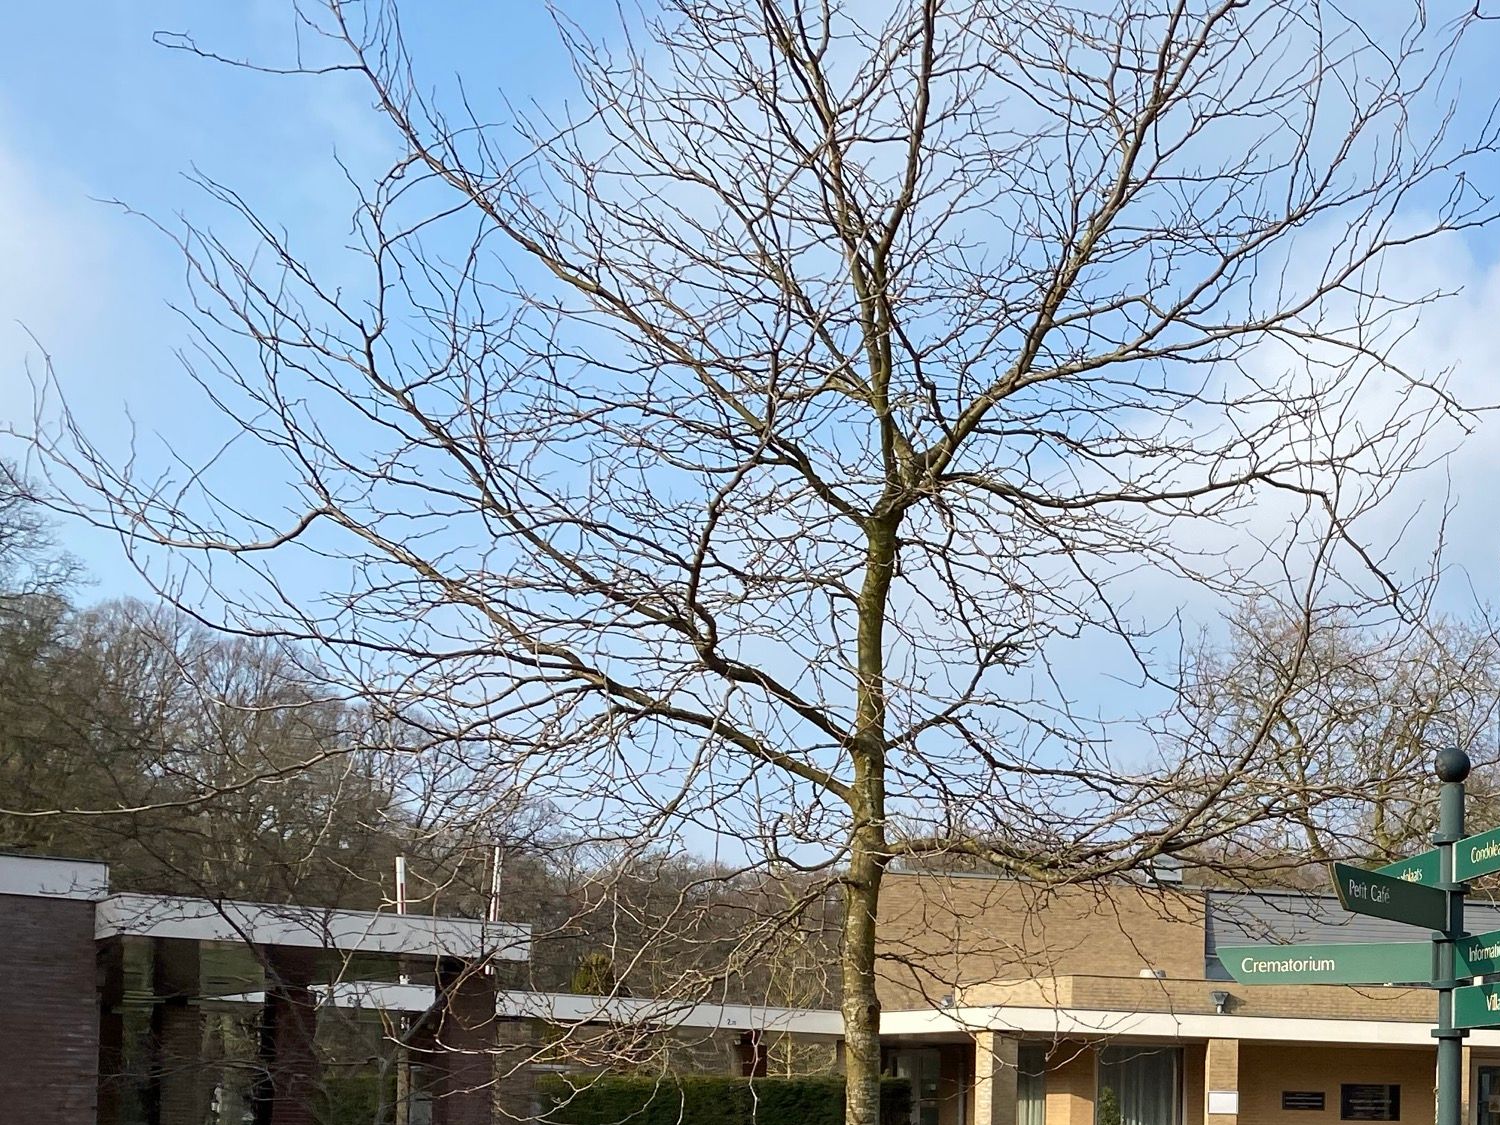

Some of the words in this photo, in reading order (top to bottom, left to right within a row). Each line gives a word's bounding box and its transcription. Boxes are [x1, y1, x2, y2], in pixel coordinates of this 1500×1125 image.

[1349, 879, 1367, 900] Petit
[1371, 884, 1391, 904] Café
[1241, 956, 1335, 973] Crematorium
